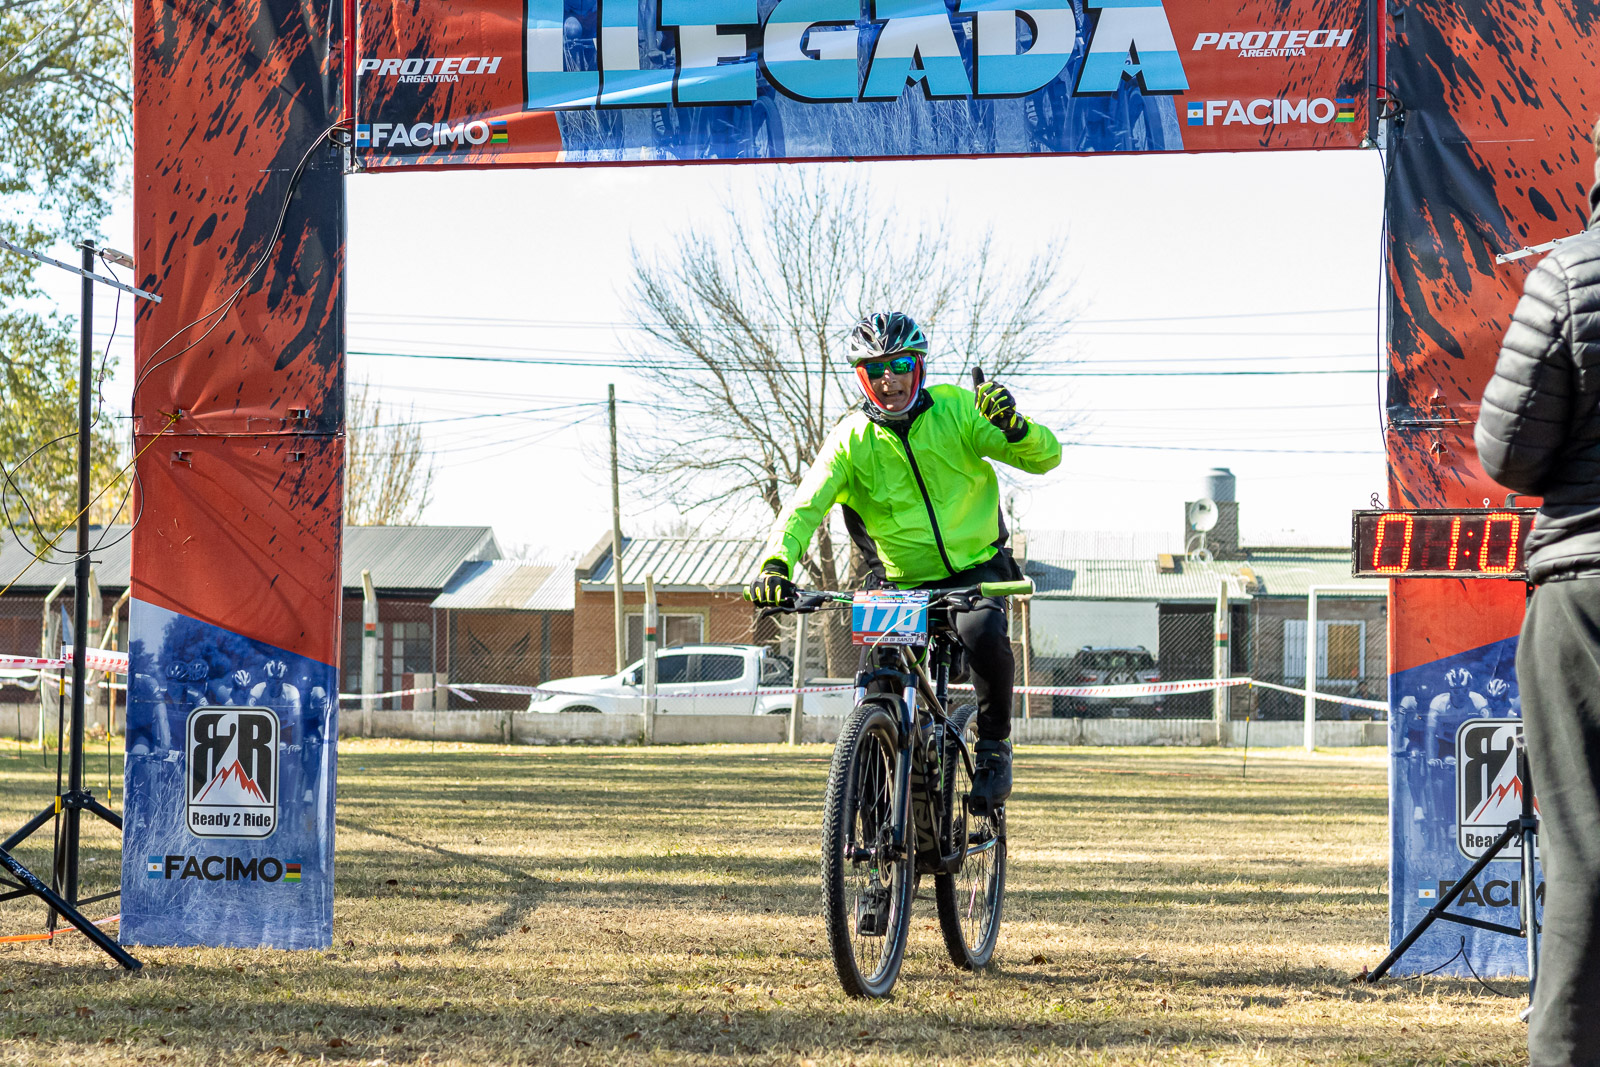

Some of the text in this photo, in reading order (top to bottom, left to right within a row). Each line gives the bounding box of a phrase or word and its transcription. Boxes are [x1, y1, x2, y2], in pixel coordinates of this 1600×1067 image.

[1191, 28, 1354, 51] PROTECH
[1238, 47, 1307, 58] ARGENTINA
[358, 56, 502, 78] PROTECH
[521, 0, 1191, 111] LLEGADA
[397, 74, 460, 84] ARGENTINA
[1205, 97, 1336, 126] FACIMO
[371, 120, 490, 148] FACIMO
[1373, 512, 1537, 574] 01:0
[861, 604, 921, 631] 170
[192, 812, 271, 828] Ready 2 Ride
[165, 855, 284, 883] FACIMO
[1439, 879, 1546, 908] FACI
